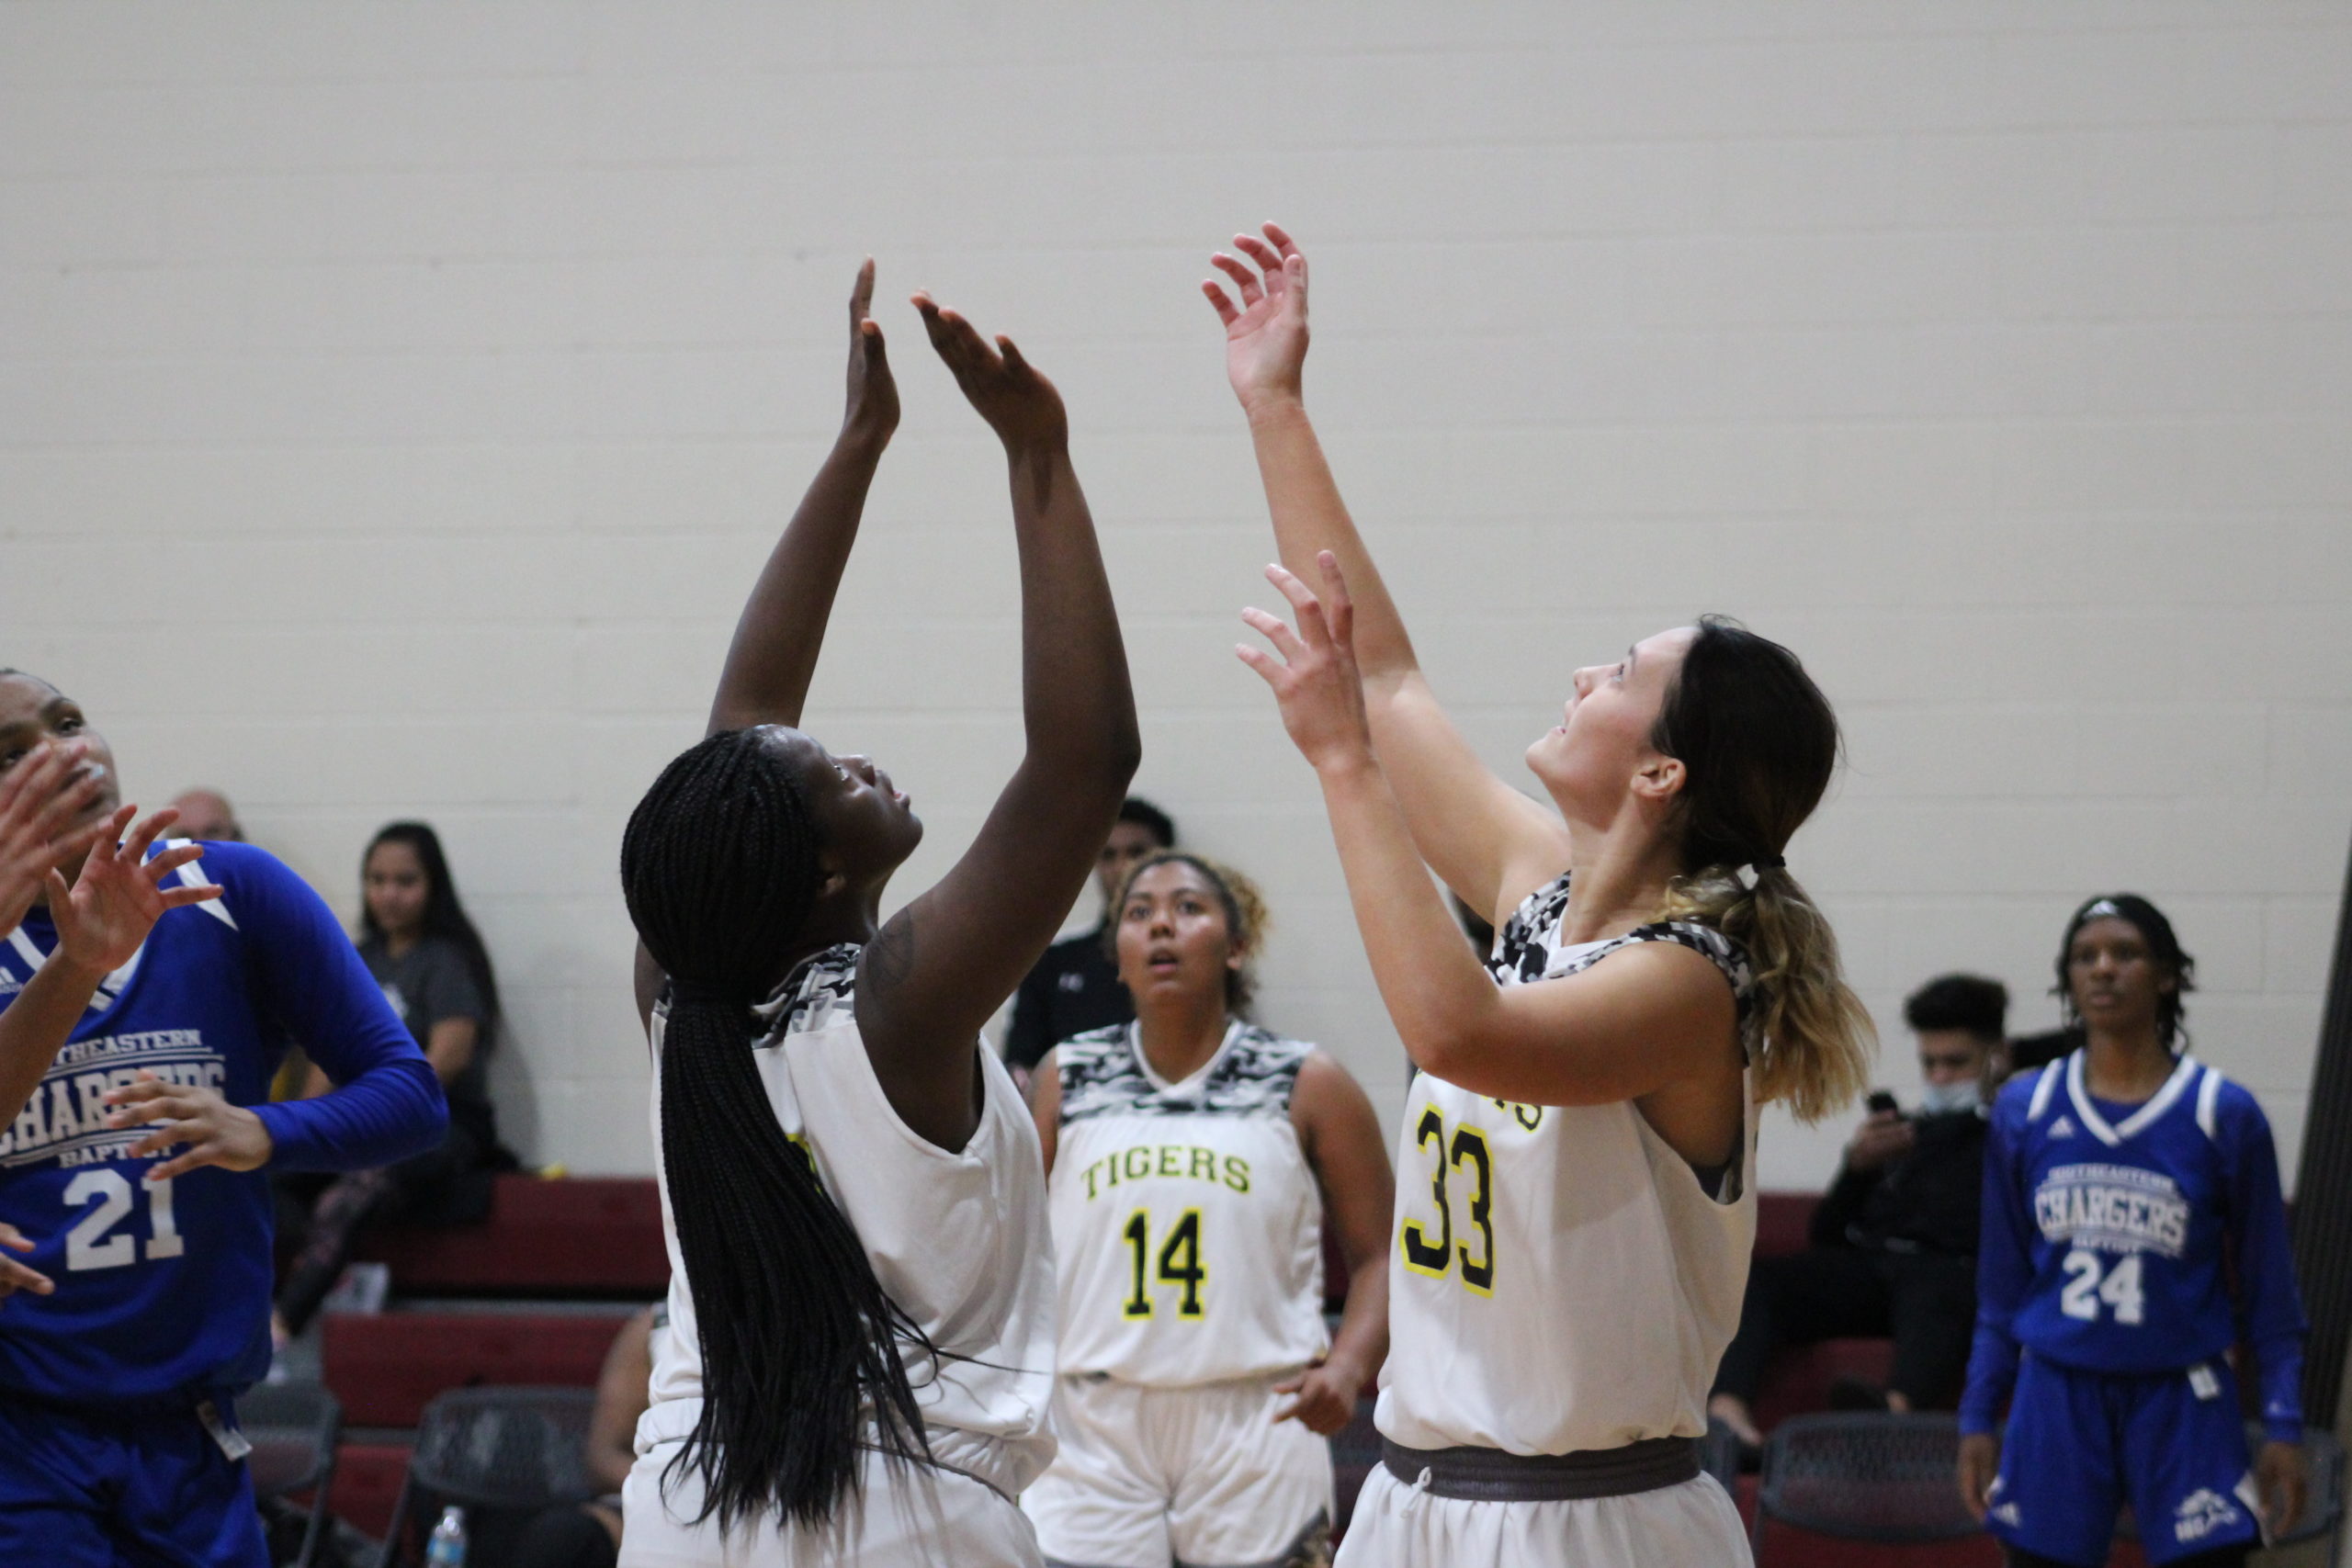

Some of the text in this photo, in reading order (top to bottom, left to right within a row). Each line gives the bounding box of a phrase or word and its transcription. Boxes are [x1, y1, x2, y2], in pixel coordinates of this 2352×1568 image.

[56, 1029, 202, 1066] THEASTERN
[1080, 1145, 1250, 1200] TIGERS
[1399, 1101, 1493, 1299] 33
[62, 1163, 185, 1271] 21
[2034, 1185, 2190, 1252] CHARGERS
[1122, 1206, 1208, 1321] 14
[2061, 1249, 2144, 1325] 24
